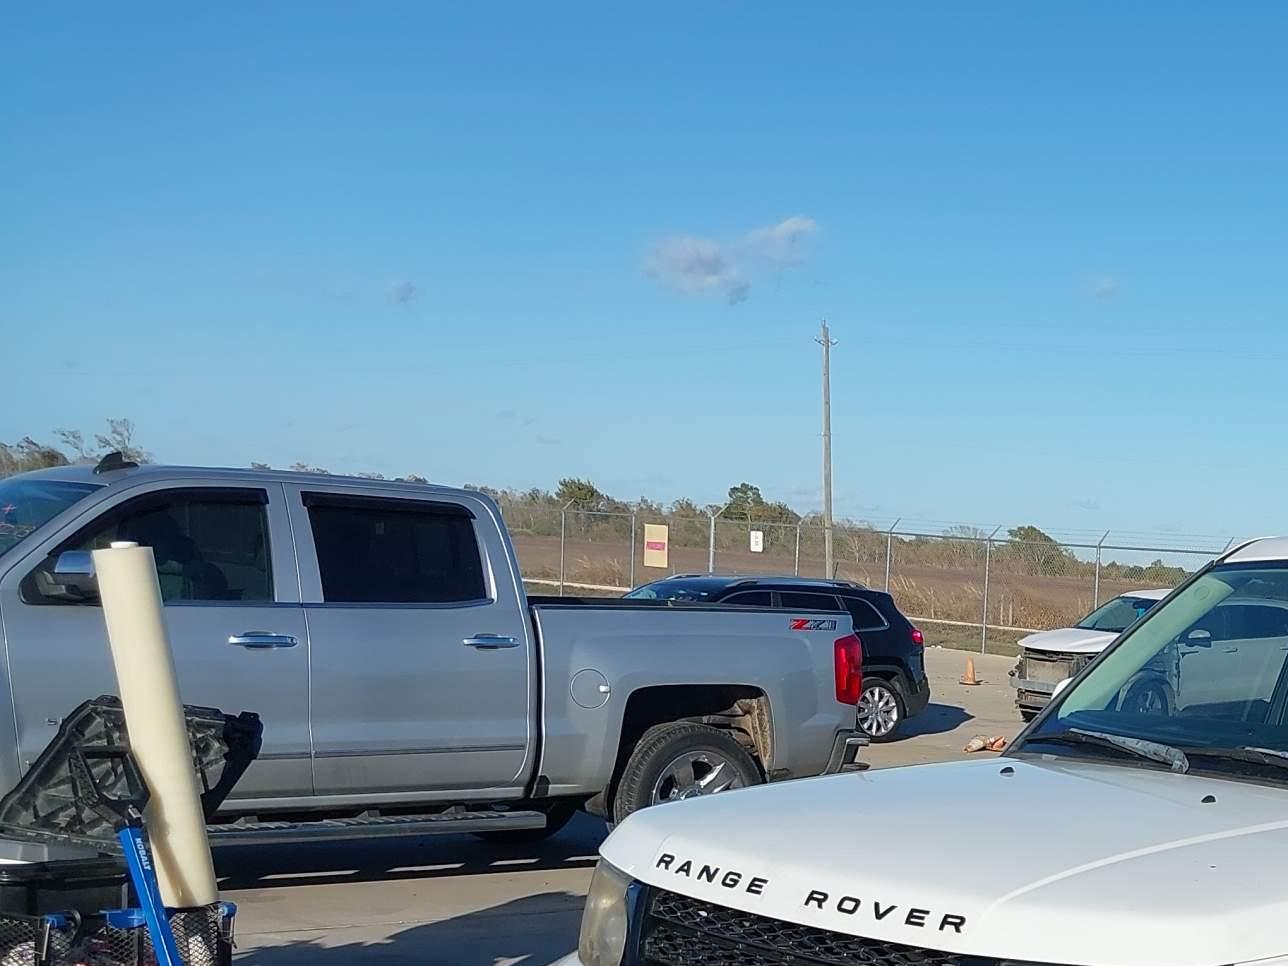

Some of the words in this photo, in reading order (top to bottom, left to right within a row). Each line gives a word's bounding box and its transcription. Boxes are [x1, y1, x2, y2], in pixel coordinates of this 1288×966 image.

[135, 837, 152, 871] KOBALT
[655, 853, 769, 896] RANGE
[803, 889, 967, 934] ROVER
